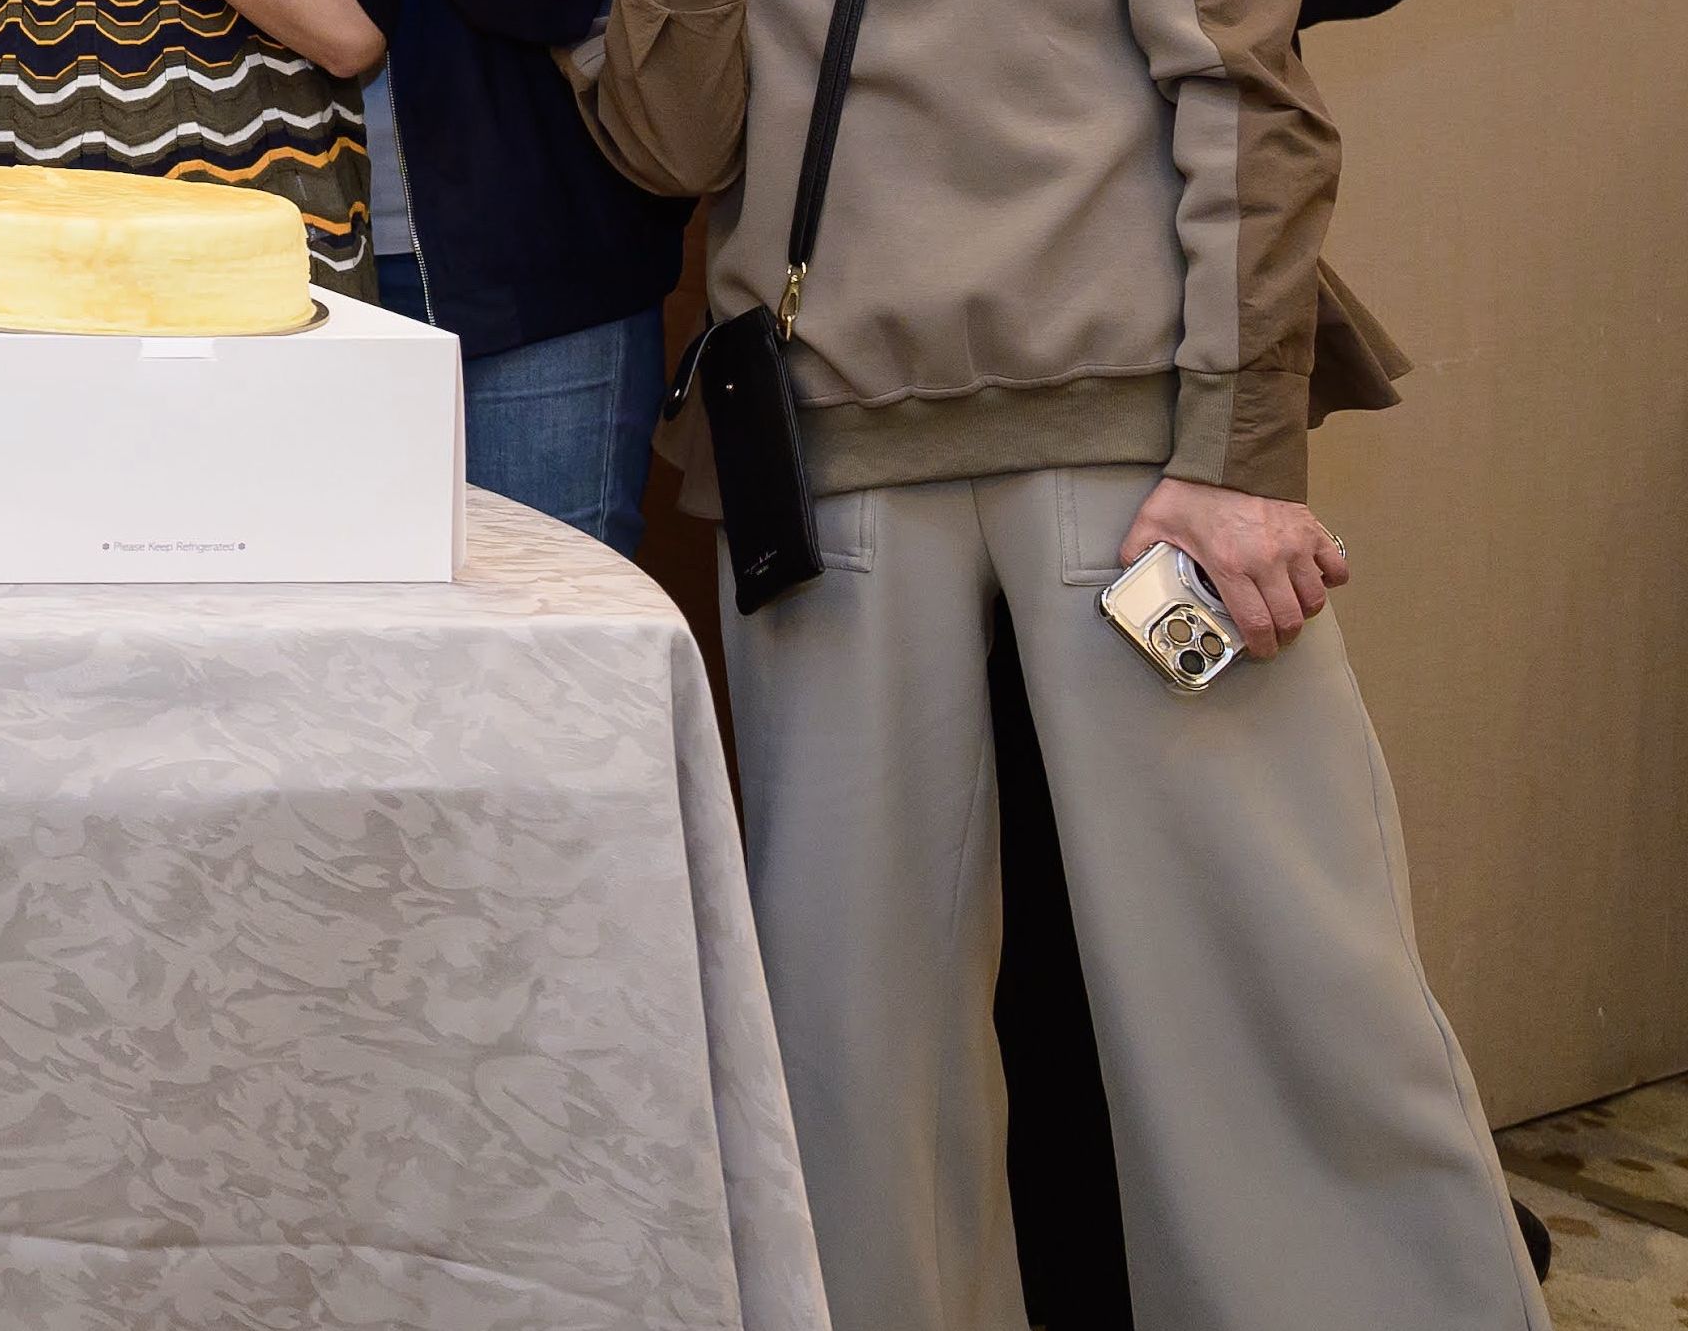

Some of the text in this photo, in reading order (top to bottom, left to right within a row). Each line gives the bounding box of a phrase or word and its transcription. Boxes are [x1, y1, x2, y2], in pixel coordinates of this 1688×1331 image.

[113, 540, 235, 554] Please Keep Refrigerated
